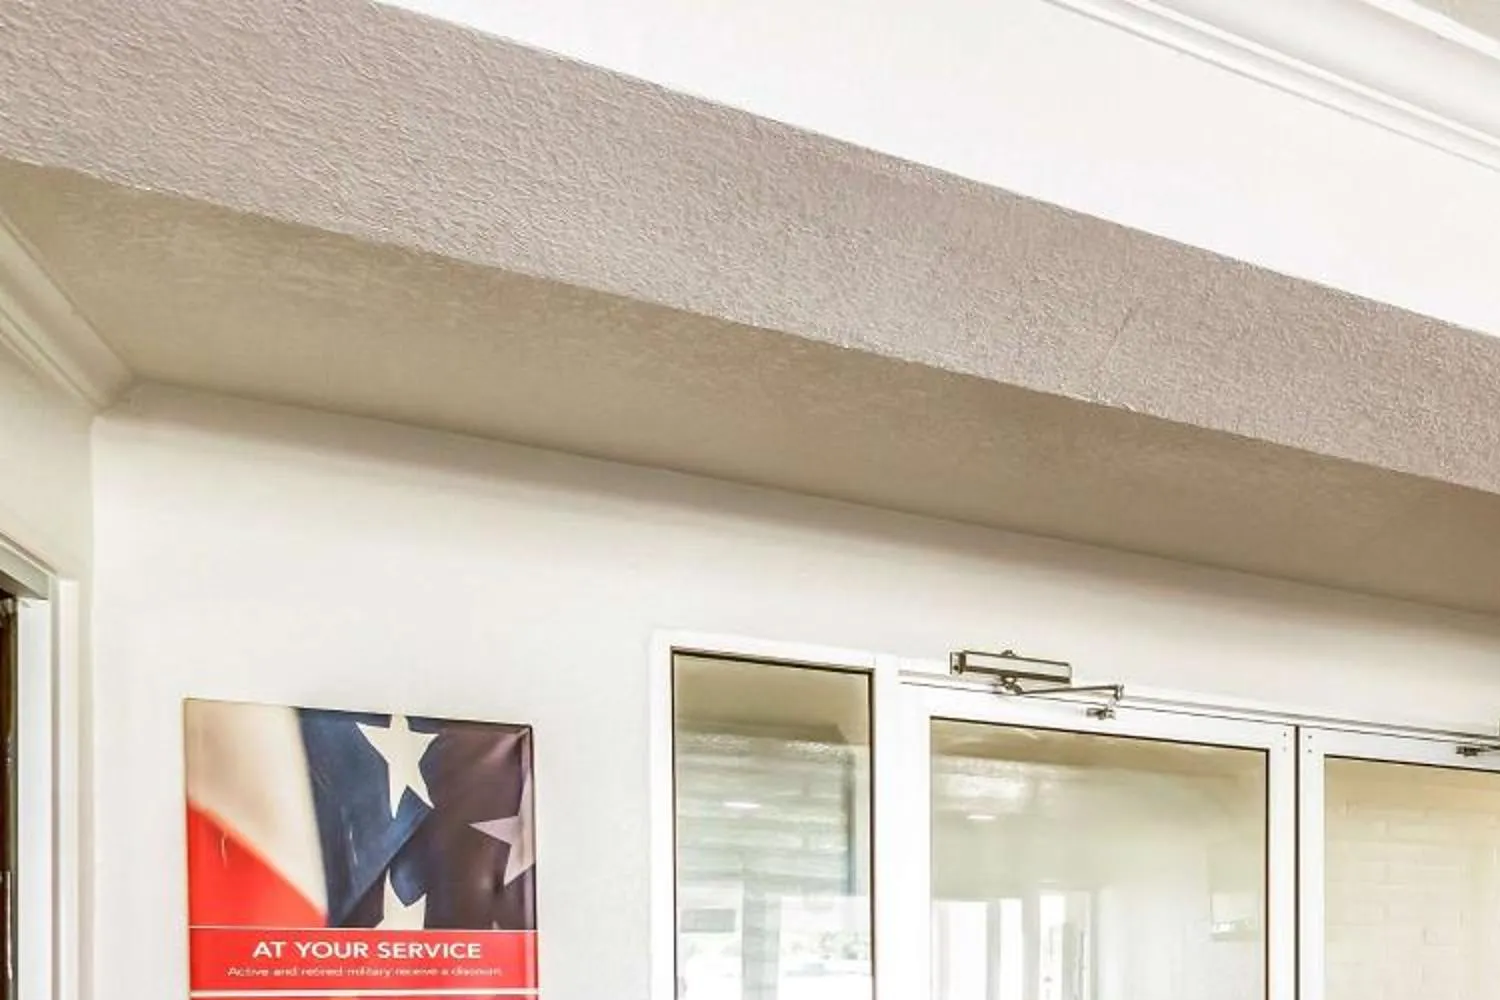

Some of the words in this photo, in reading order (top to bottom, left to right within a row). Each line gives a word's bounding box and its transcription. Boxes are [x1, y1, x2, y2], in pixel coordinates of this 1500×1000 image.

[251, 940, 288, 959] AT
[293, 940, 369, 960] YOUR
[376, 941, 482, 960] SERVICE
[226, 966, 270, 977] Active
[272, 966, 299, 977] and
[301, 966, 344, 977] retired
[346, 966, 392, 979] military
